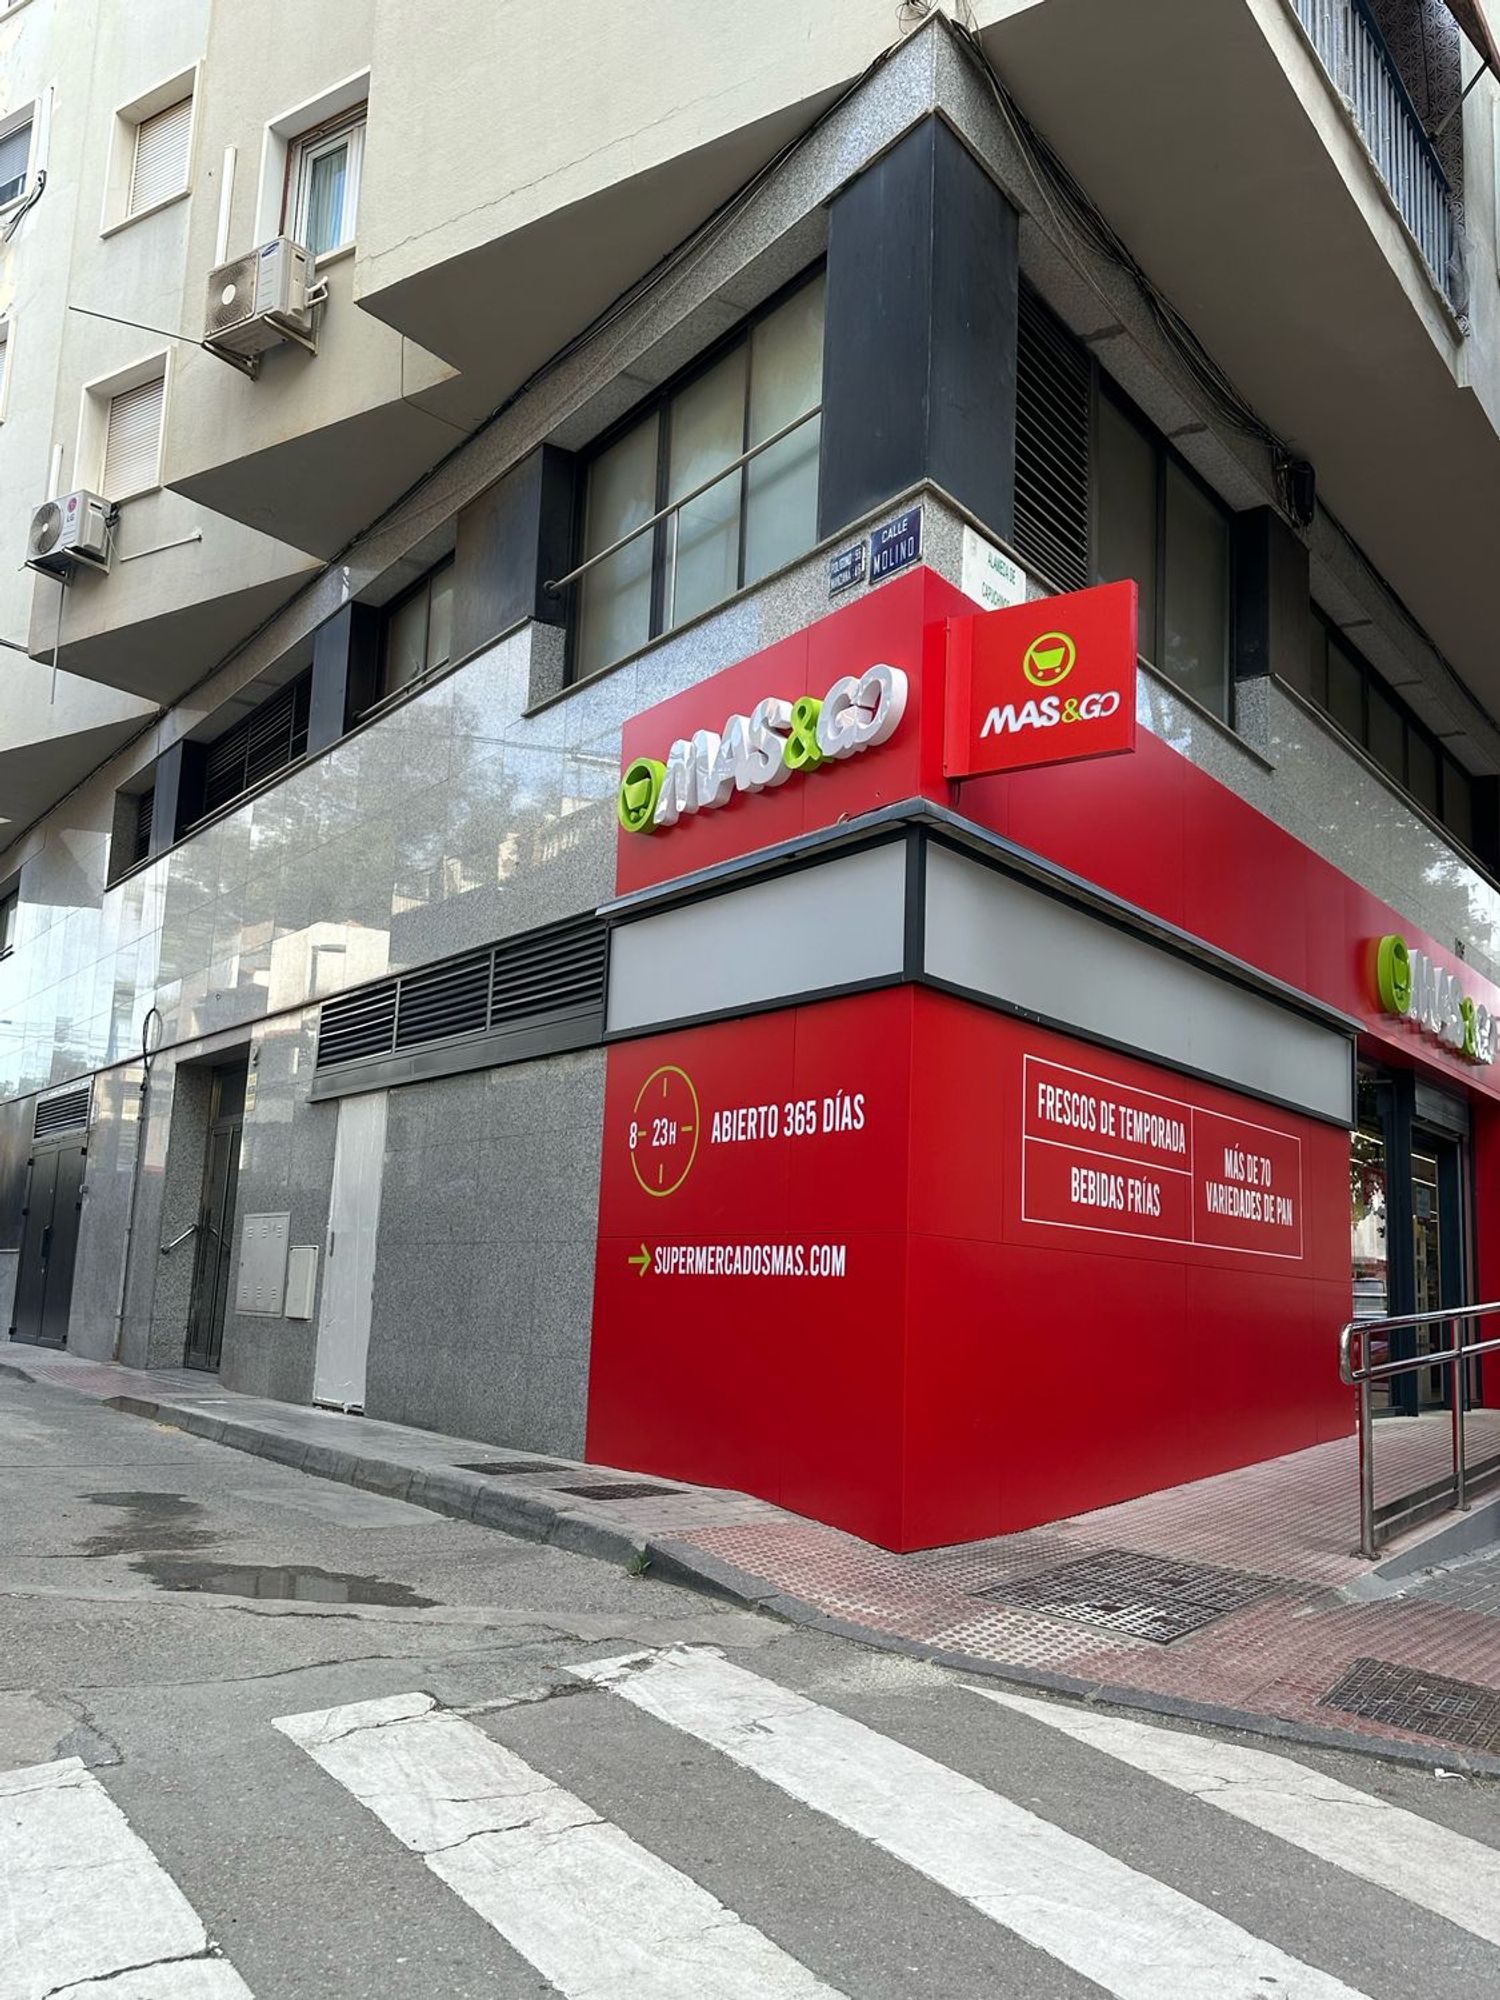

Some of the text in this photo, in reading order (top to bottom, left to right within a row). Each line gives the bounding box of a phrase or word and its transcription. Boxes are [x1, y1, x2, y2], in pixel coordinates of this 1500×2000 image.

[881, 518, 908, 543] CALLE
[873, 536, 915, 575] MOLINO
[979, 690, 1121, 739] MAS&GO
[654, 663, 908, 827] MAS&GO
[711, 1089, 865, 1144] ABIERTO 365 DÍAS
[1037, 1082, 1186, 1154] FRESCOS DE TEMPORADA
[1224, 1142, 1272, 1187] MÁS DE 70
[1071, 1166, 1161, 1217] BEBIDAS FRÍAS
[1205, 1181, 1293, 1227] VARIEDADES DE PAN
[654, 1245, 846, 1277] SUPERMERCADOSMAS.COM
